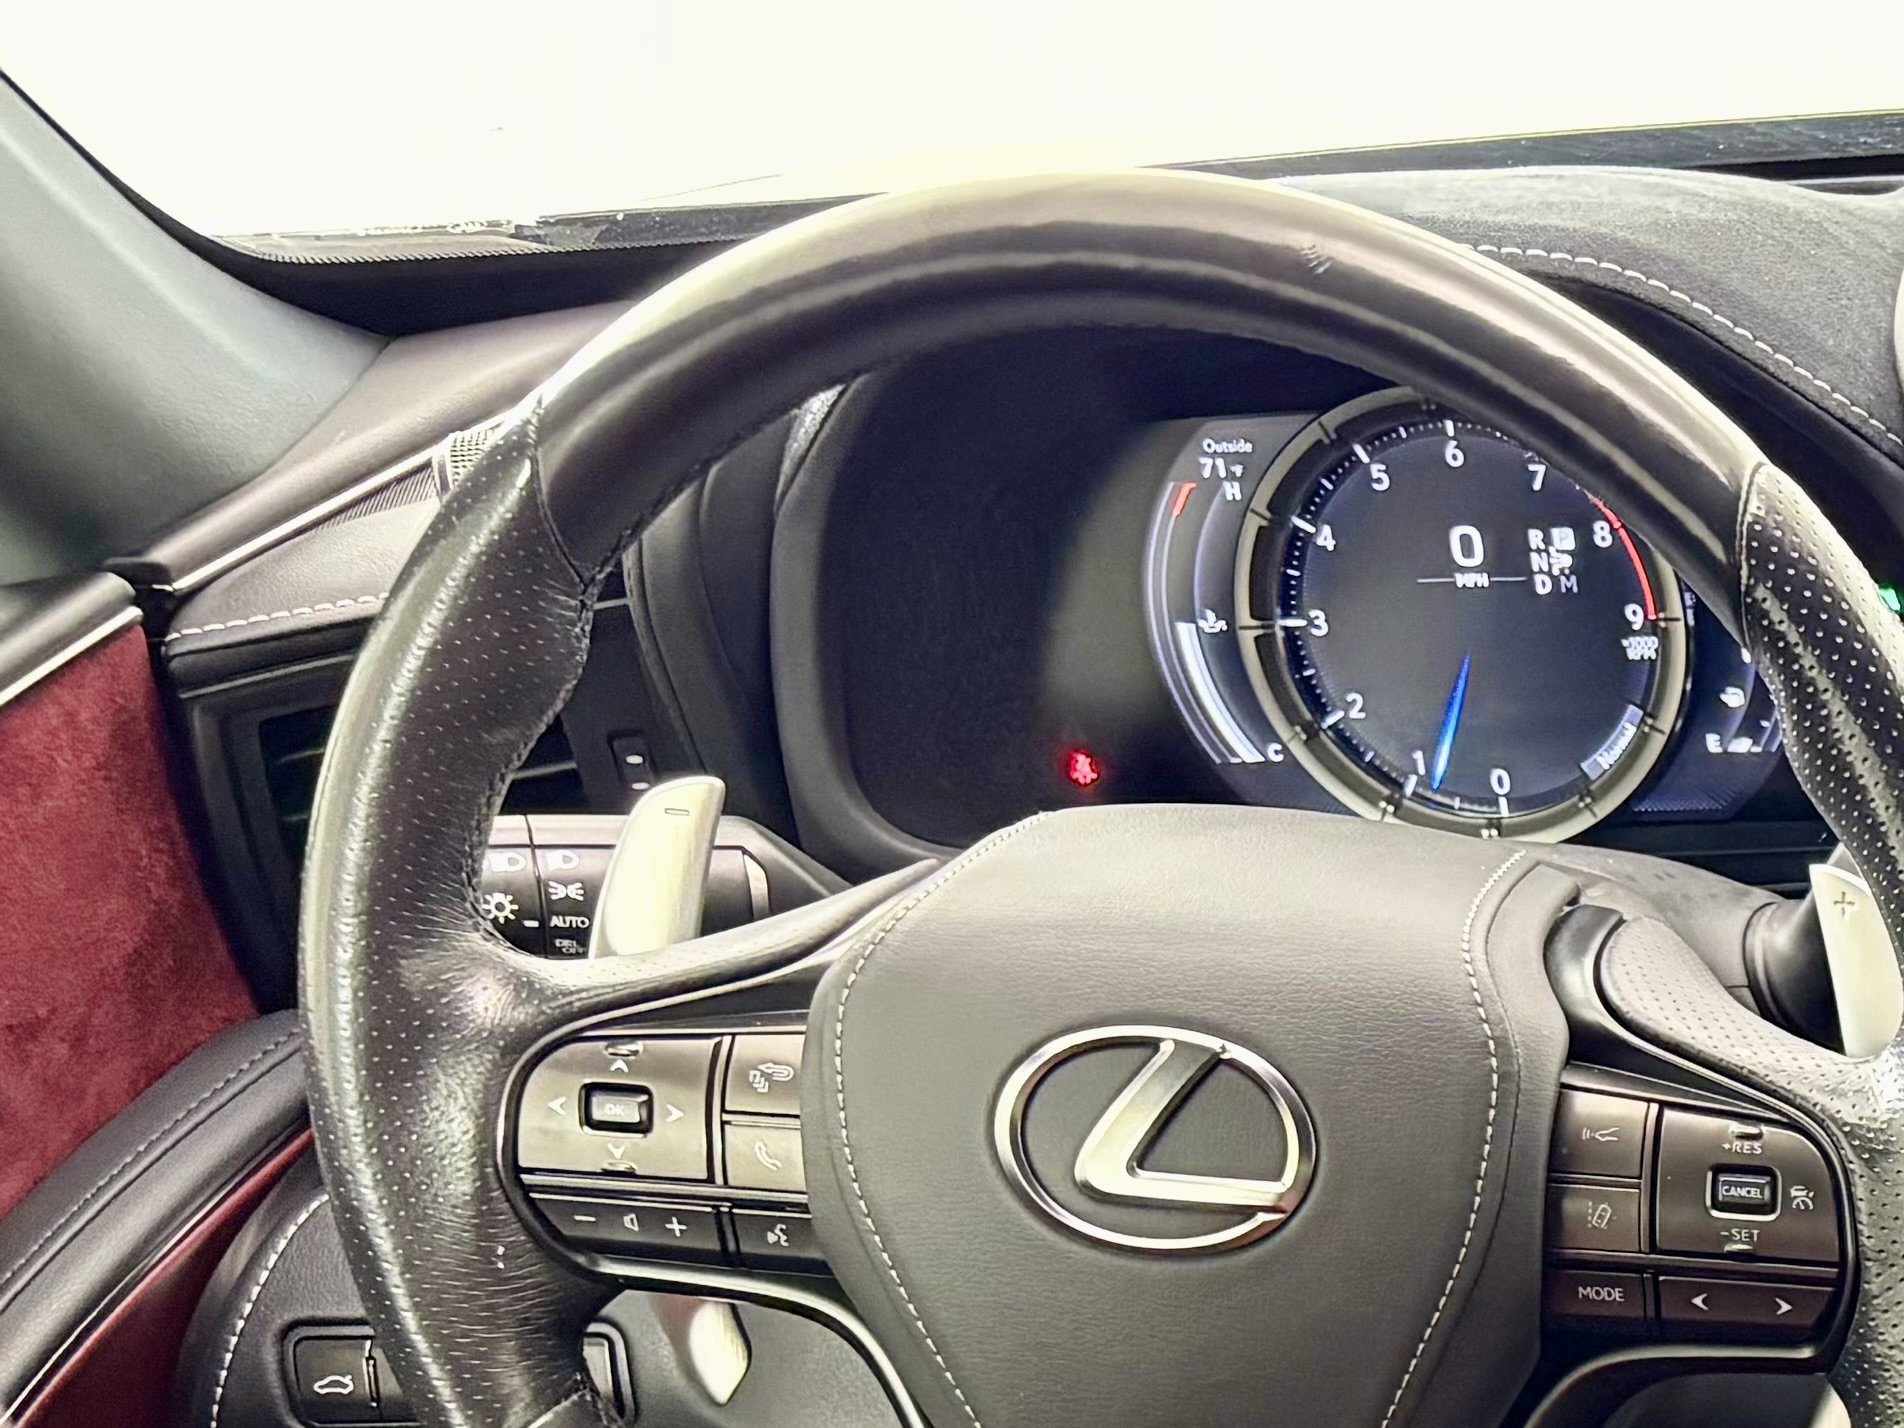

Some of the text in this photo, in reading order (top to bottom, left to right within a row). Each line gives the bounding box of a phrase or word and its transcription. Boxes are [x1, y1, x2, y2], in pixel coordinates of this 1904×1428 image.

[1202, 437, 1253, 454] Outside
[1444, 440, 1465, 468] 6
[1369, 462, 1391, 492] 5
[1527, 463, 1547, 492] 7
[1222, 480, 1243, 501] H
[1315, 523, 1337, 552] 4
[1527, 527, 1546, 550] R
[1592, 519, 1614, 549] 8
[1449, 524, 1486, 569] 0
[1530, 551, 1550, 573] N
[1453, 571, 1490, 589] MPH
[1533, 573, 1578, 596] D M
[1307, 609, 1329, 637] 3
[1624, 602, 1645, 631] 9
[1345, 692, 1367, 720] 2
[1267, 742, 1285, 763] C
[1705, 733, 1723, 753] E
[1412, 750, 1426, 776] 1
[1489, 767, 1511, 796] 0
[549, 914, 591, 929] AUTO
[604, 1102, 626, 1117] OK
[1721, 1142, 1764, 1155] +RES
[1722, 1184, 1764, 1200] CANCEL
[1577, 1285, 1626, 1302] MODE
